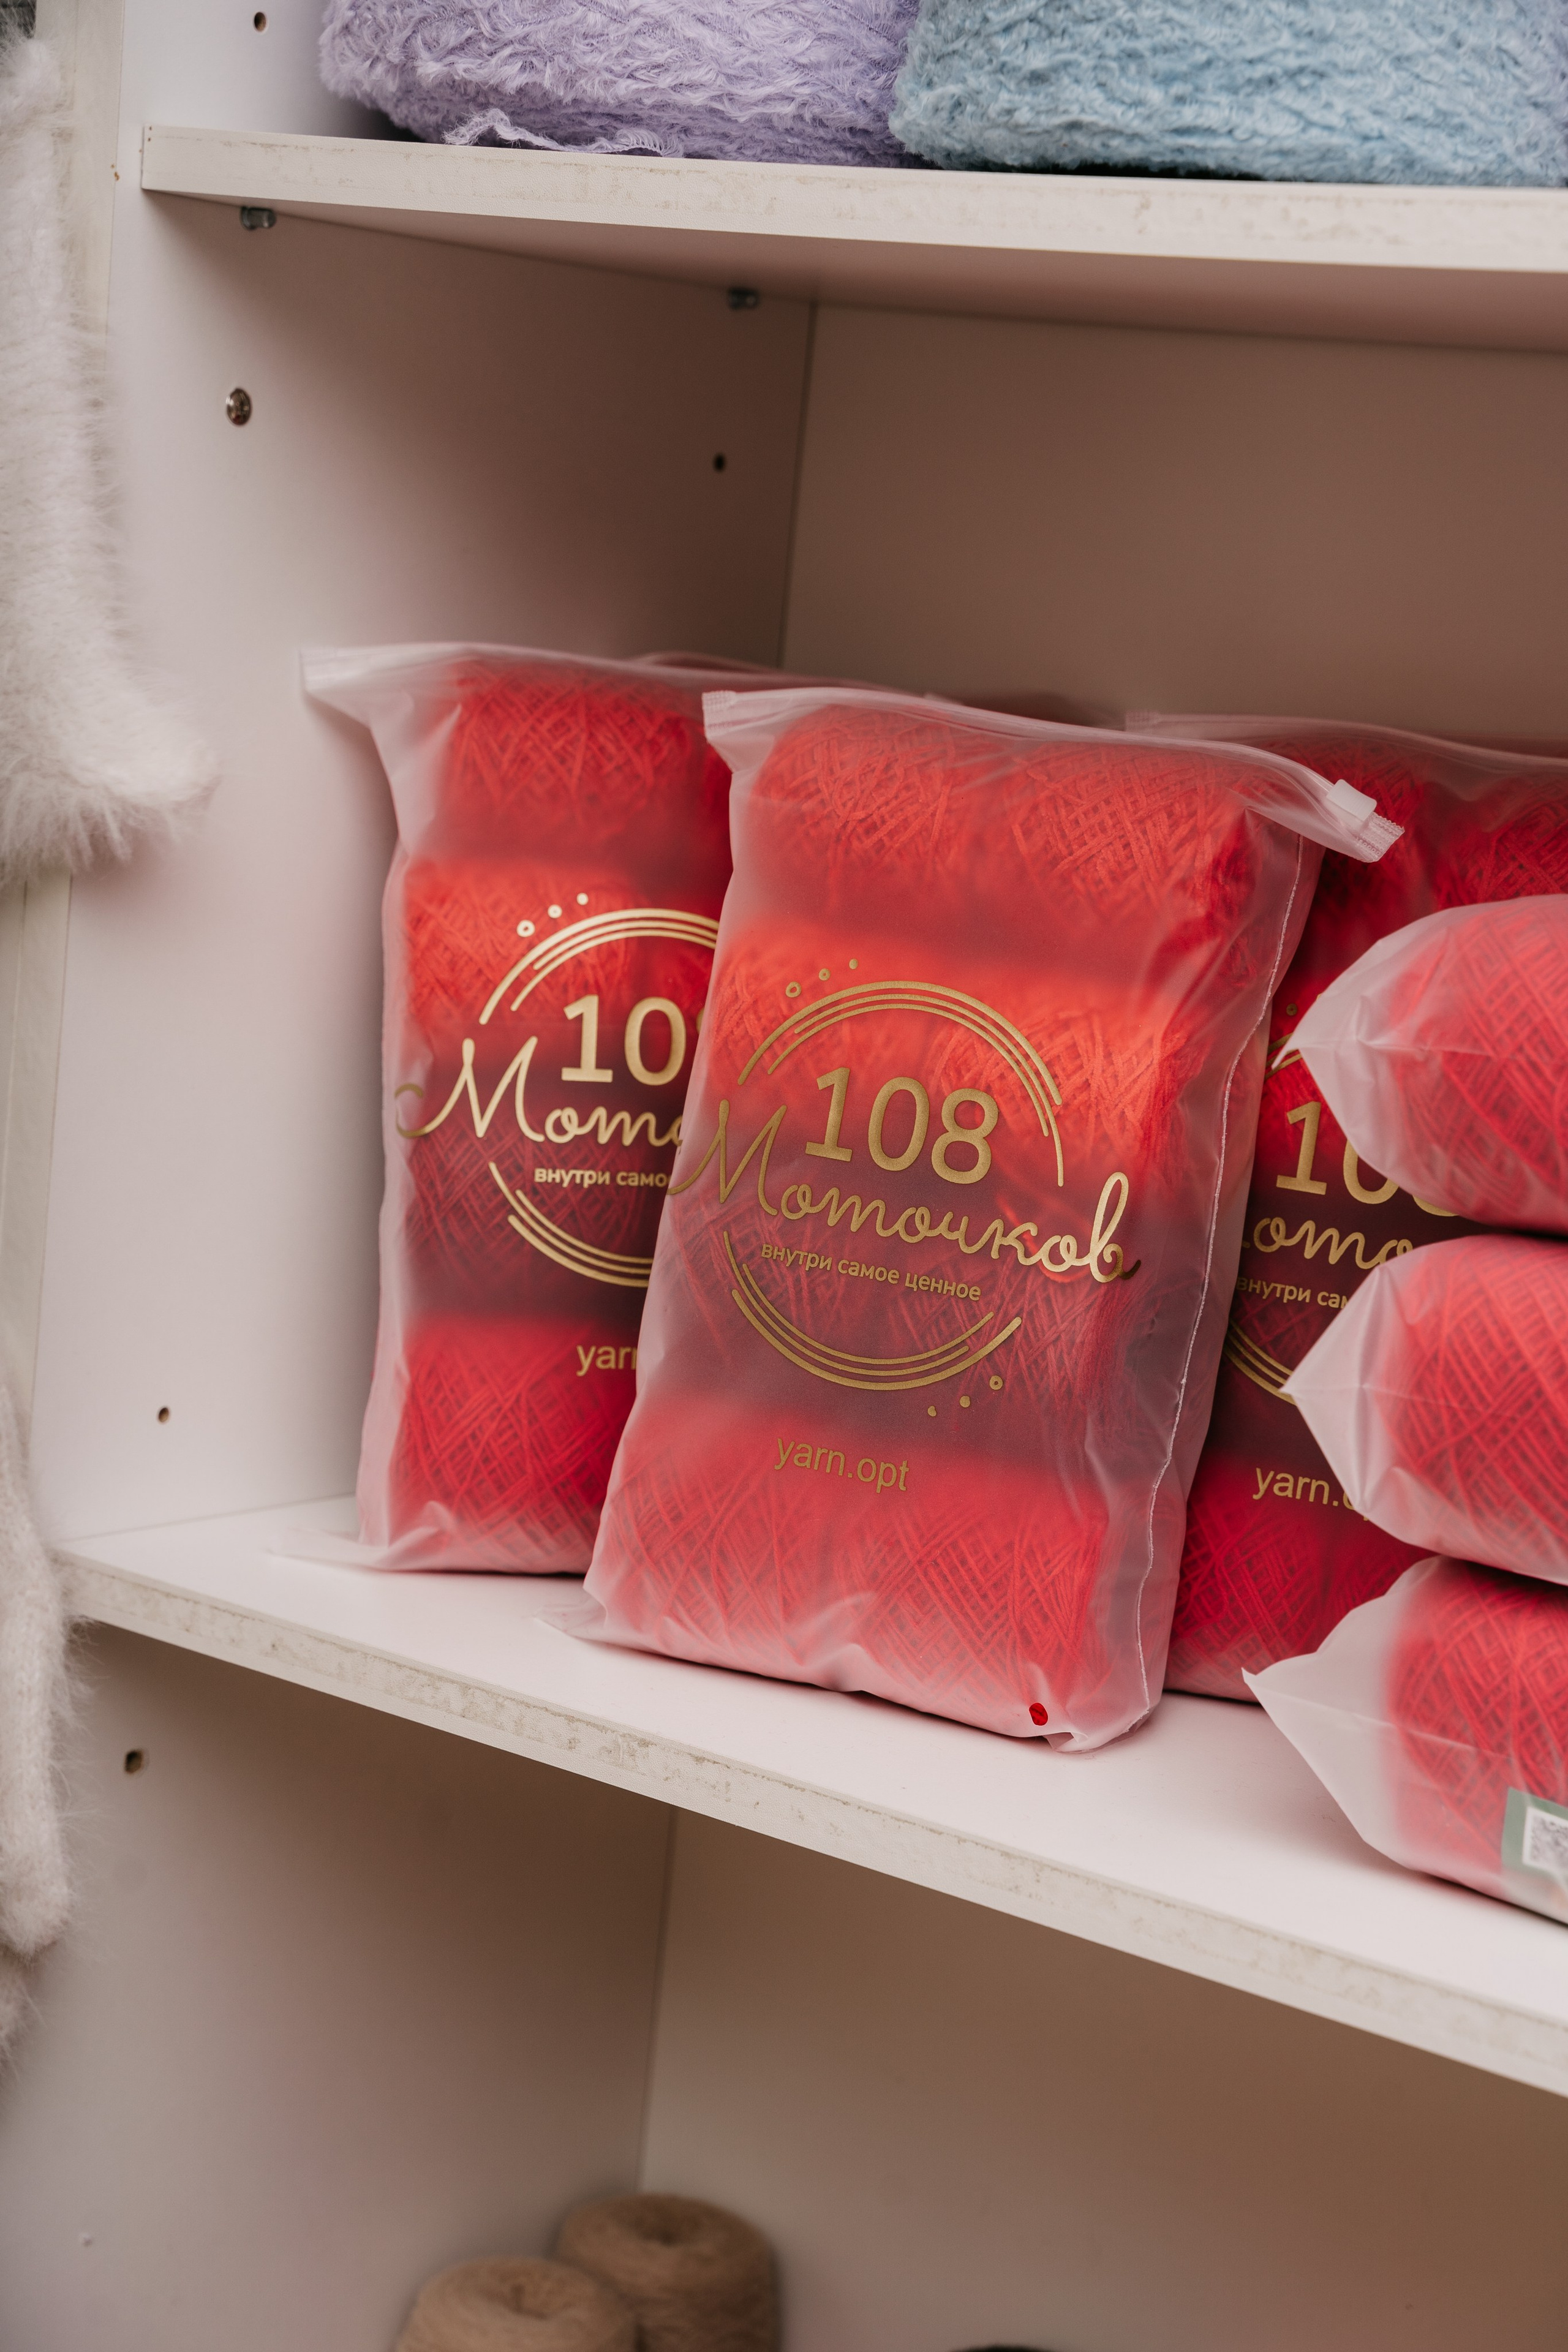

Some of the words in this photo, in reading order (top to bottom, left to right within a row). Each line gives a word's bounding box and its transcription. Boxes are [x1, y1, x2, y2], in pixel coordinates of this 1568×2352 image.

[560, 995, 704, 1086] 10
[805, 1067, 999, 1185] 108
[1276, 1101, 1460, 1216] 10
[534, 1167, 611, 1188] внутри
[616, 1170, 671, 1187] само
[667, 1099, 1142, 1283] Моточков
[761, 1244, 832, 1271] внутри
[837, 1259, 900, 1284] самое
[905, 1272, 981, 1302] ценное
[1235, 1276, 1311, 1303] внутри
[774, 1438, 910, 1494] yarn.opt
